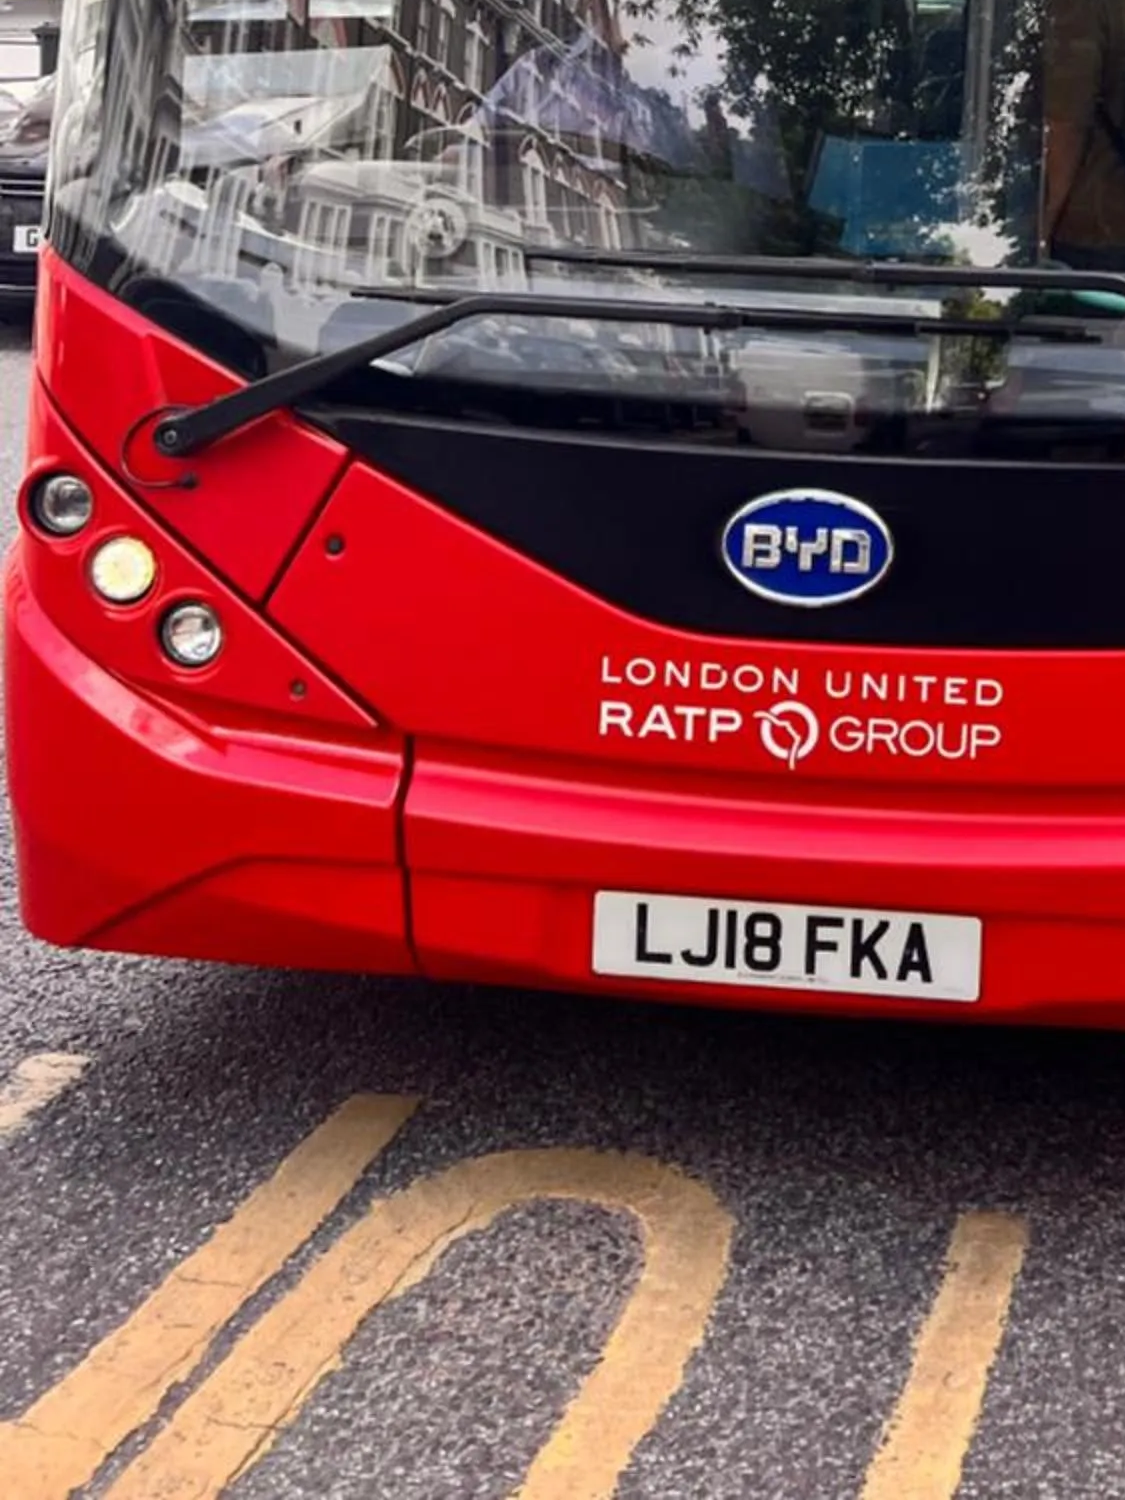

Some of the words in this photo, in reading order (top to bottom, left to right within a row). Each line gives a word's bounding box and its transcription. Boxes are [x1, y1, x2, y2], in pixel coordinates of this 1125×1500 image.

[741, 523, 871, 573] BYD
[602, 656, 799, 695] LONDON
[825, 670, 1003, 706] UNITED
[599, 701, 742, 742] RATP
[829, 716, 1001, 759] GROUP
[635, 903, 783, 972] LJ18
[804, 915, 933, 983] FKA
